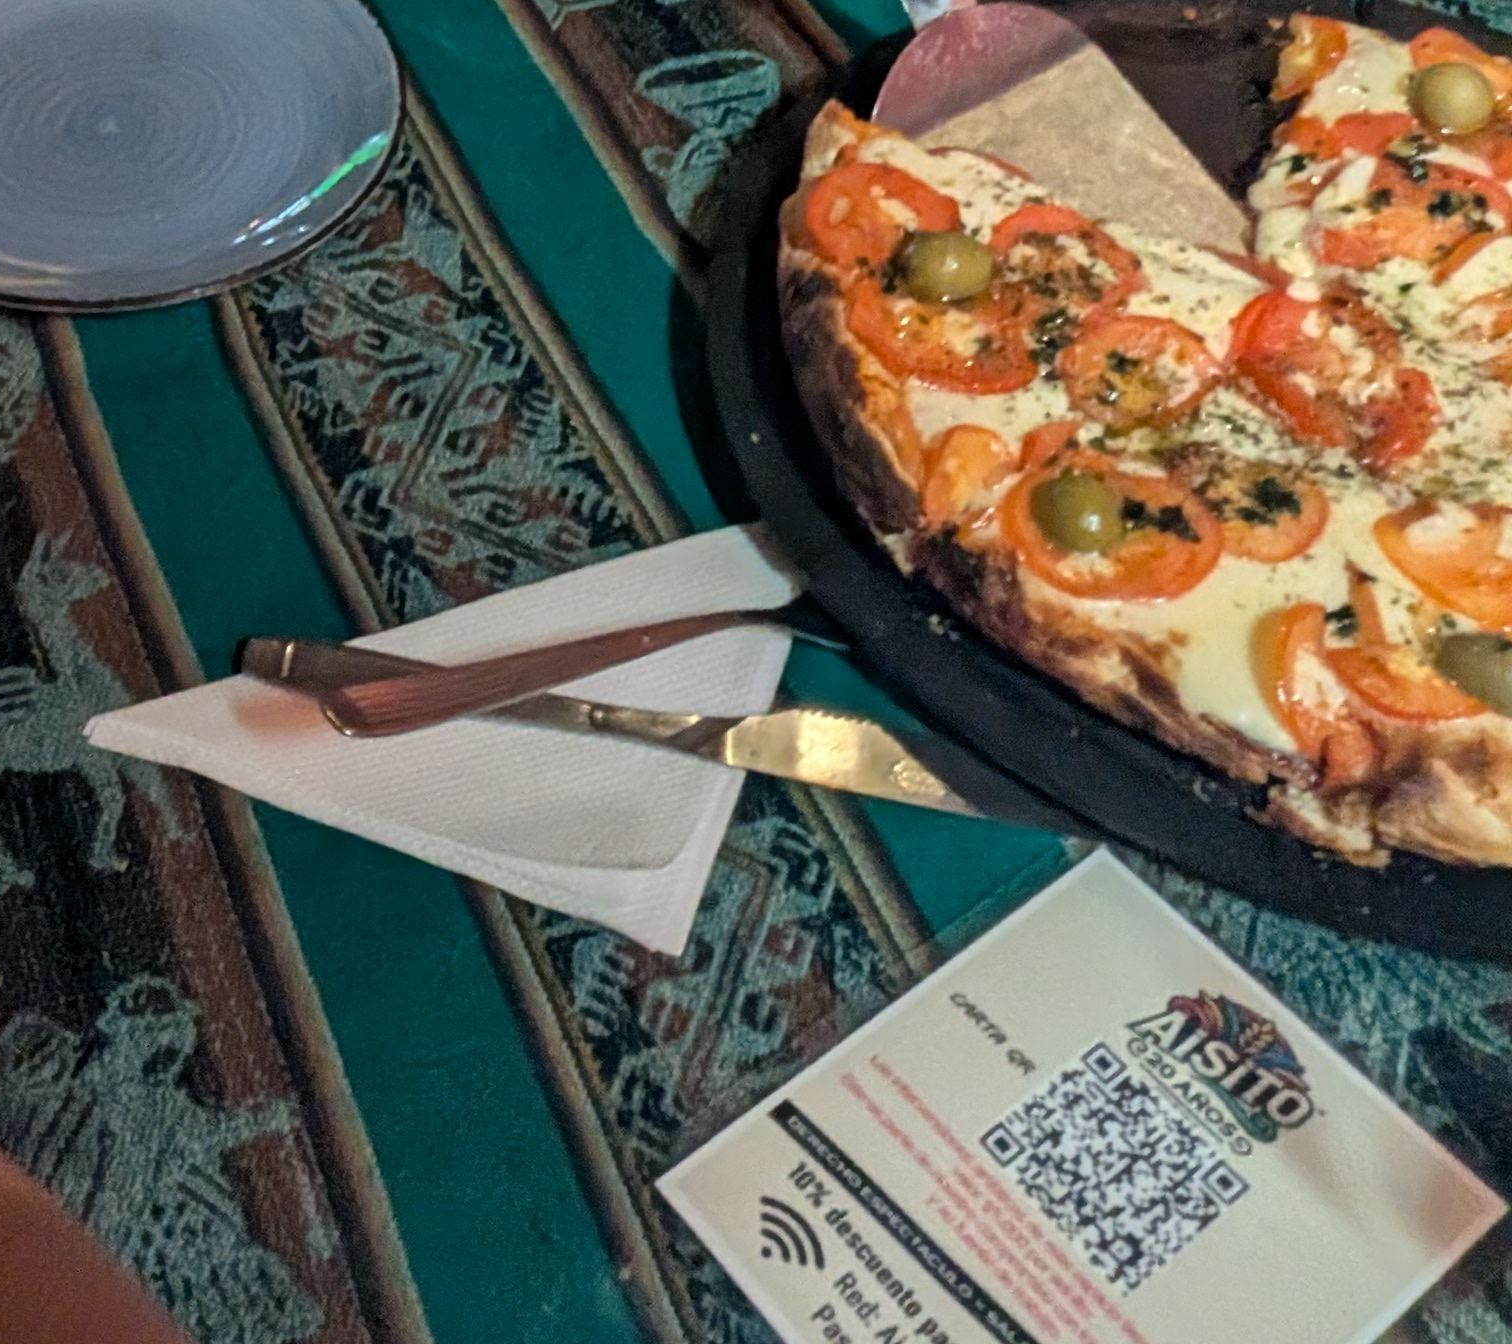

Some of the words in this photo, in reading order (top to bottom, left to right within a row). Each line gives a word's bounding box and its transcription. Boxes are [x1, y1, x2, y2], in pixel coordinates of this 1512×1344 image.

[950, 992, 1008, 1045] CARTA
[1006, 1047, 1037, 1075] QR
[1128, 1009, 1314, 1129] AISITO
[1146, 1052, 1177, 1079] 20
[788, 1162, 832, 1208] 10%
[824, 1208, 923, 1318] descuento
[834, 1271, 880, 1329] Red:
